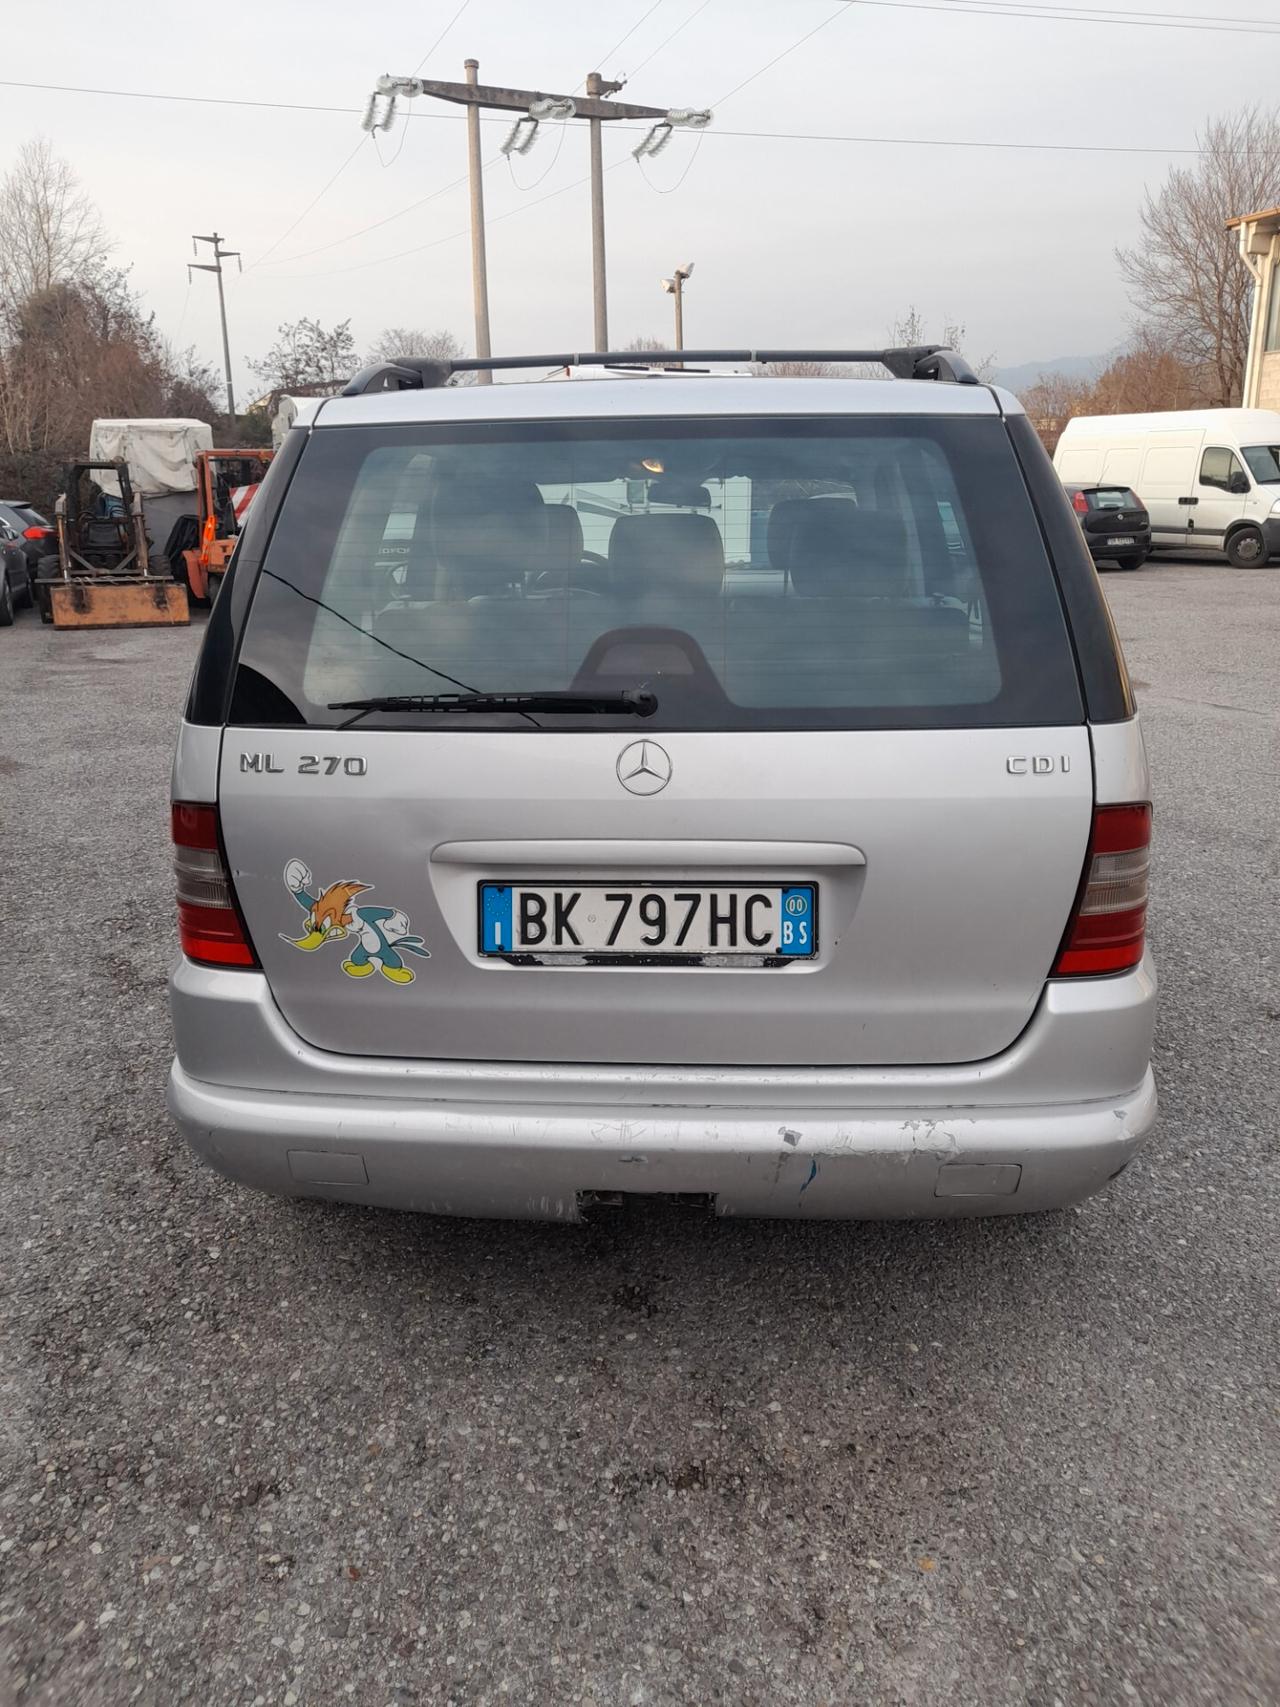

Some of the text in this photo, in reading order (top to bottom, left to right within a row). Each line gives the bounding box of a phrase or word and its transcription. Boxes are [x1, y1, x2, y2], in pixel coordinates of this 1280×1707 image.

[240, 752, 367, 776] ML 270
[1006, 755, 1071, 774] CDI
[520, 892, 773, 947] BK 797HC
